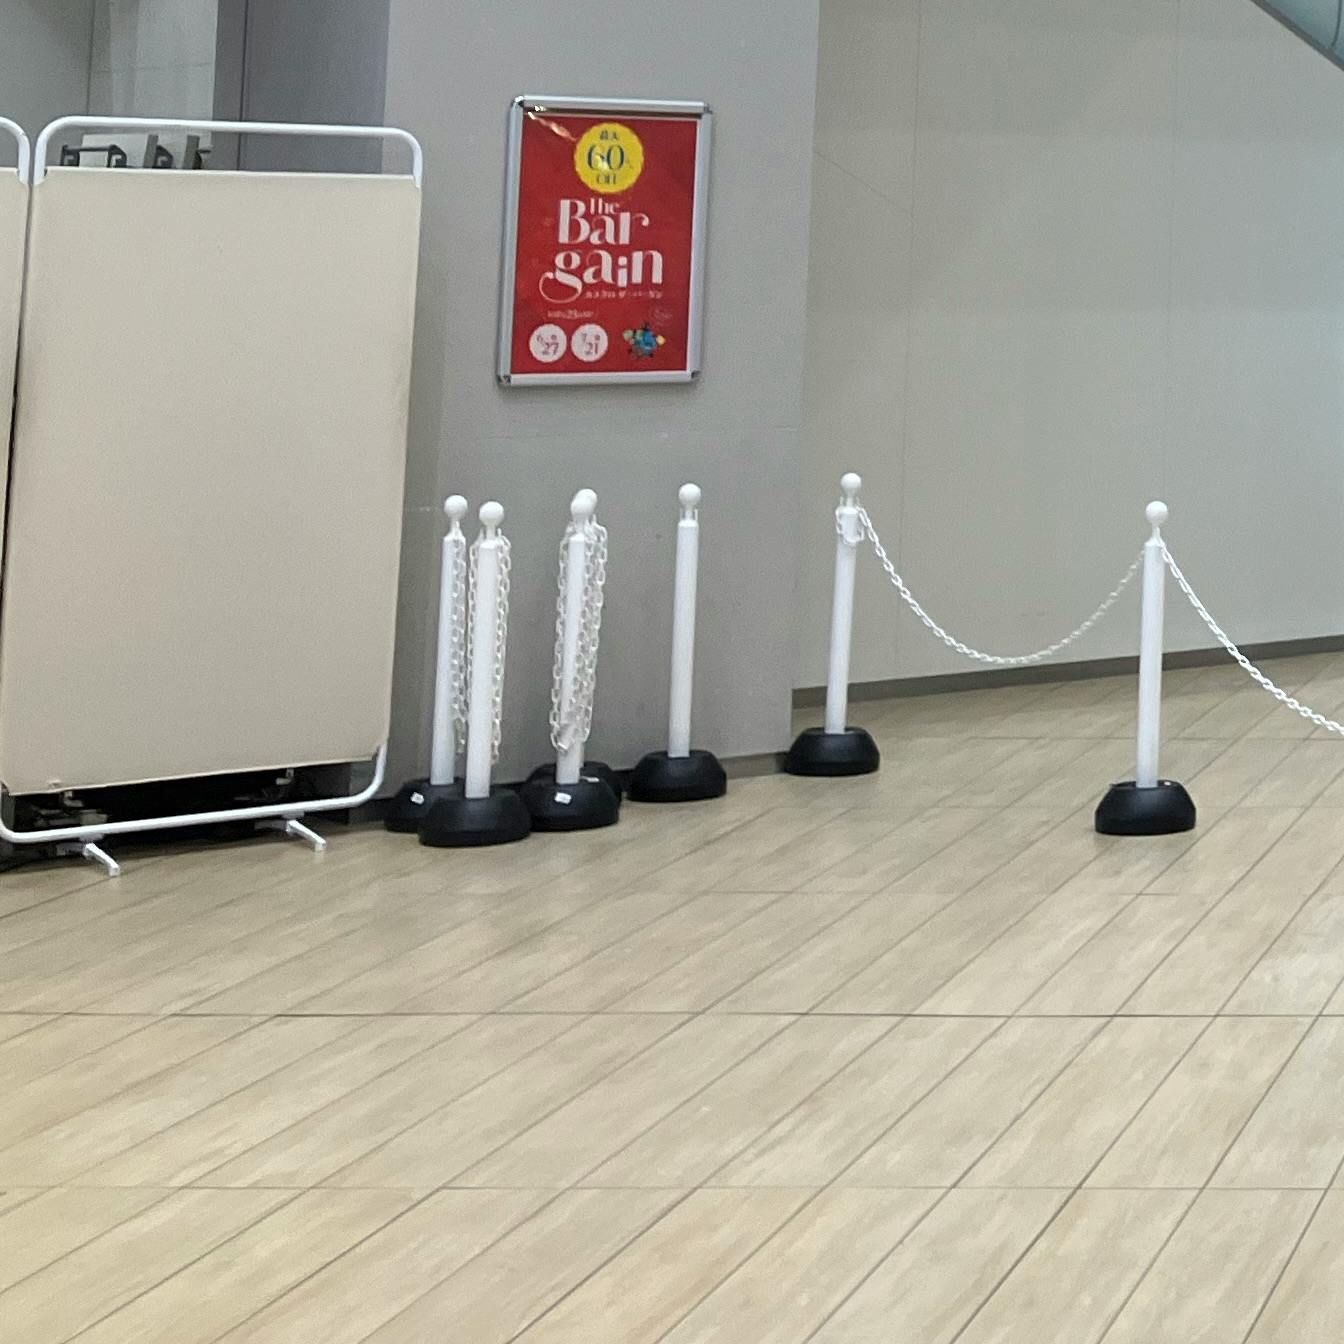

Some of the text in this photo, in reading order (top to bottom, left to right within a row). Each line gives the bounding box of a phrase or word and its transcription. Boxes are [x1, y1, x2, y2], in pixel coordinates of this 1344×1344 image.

[558, 199, 650, 246] Bar
[588, 197, 620, 215] The
[538, 249, 664, 304] gain
